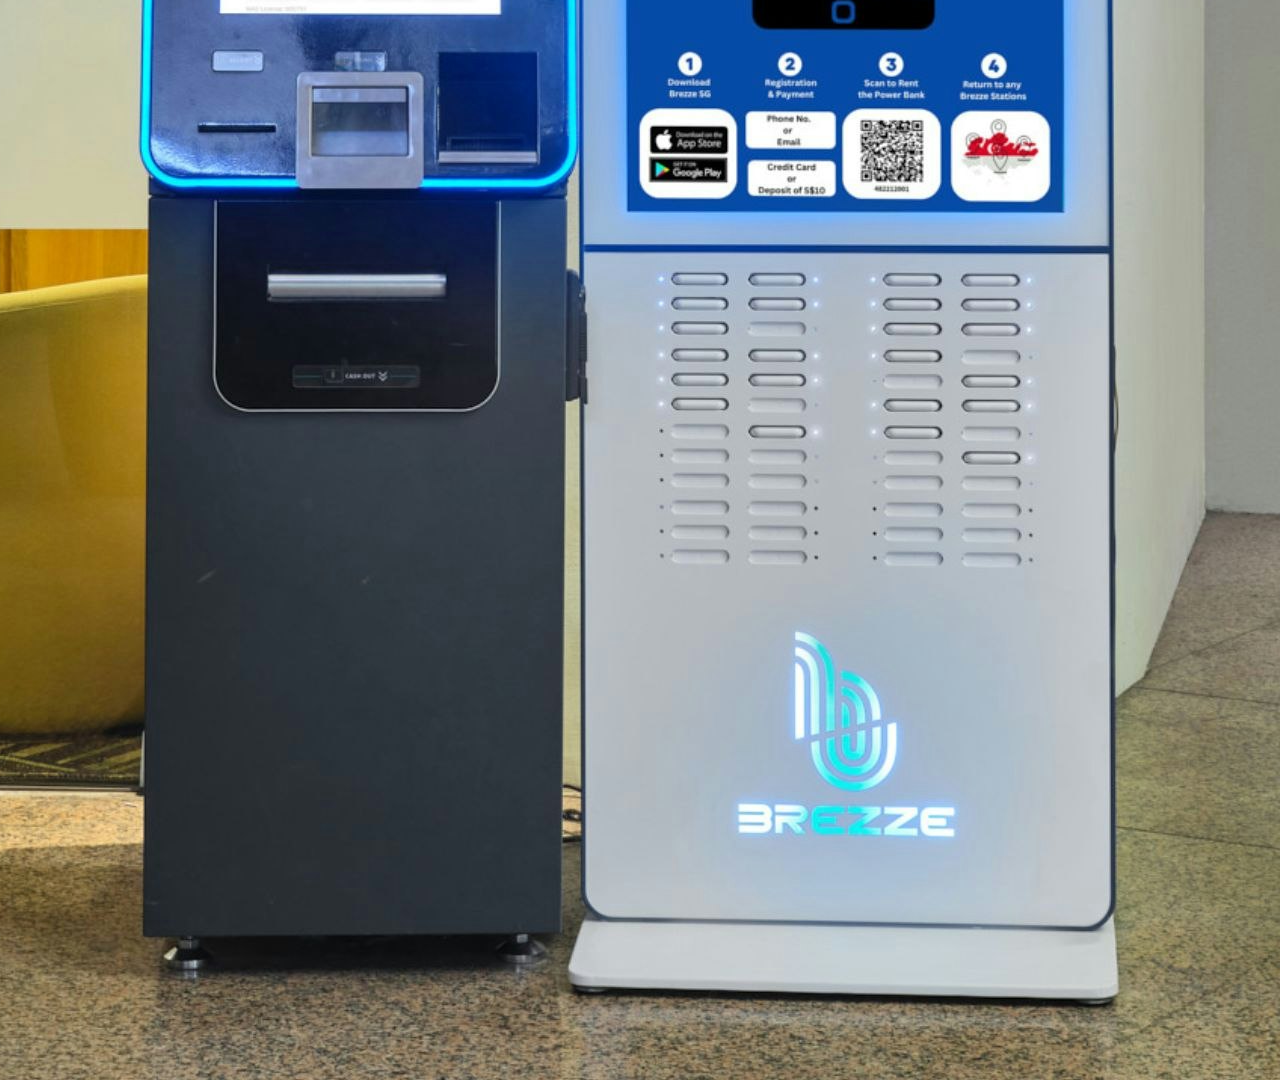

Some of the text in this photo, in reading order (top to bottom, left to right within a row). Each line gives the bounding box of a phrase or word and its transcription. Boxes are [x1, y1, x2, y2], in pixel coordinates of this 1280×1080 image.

[685, 57, 694, 70] 1
[785, 57, 795, 70] 2
[886, 58, 897, 71] 3
[988, 59, 1000, 73] 4
[668, 78, 711, 86] Download
[765, 78, 817, 88] Registration
[864, 79, 919, 87] Scan to Rent
[963, 81, 1022, 91] Return to any
[669, 90, 711, 98] Brezze SG
[768, 90, 814, 100] & Payment
[858, 91, 925, 99] the Power Bank
[960, 92, 1027, 100] Brezze Stations
[767, 115, 811, 123] Phone No.
[677, 140, 721, 149] App Store
[777, 138, 801, 146] Email
[768, 163, 816, 171] Credit Card
[673, 168, 721, 179] Google Play
[758, 187, 791, 195] Deposit
[738, 803, 956, 837] BREZZE
